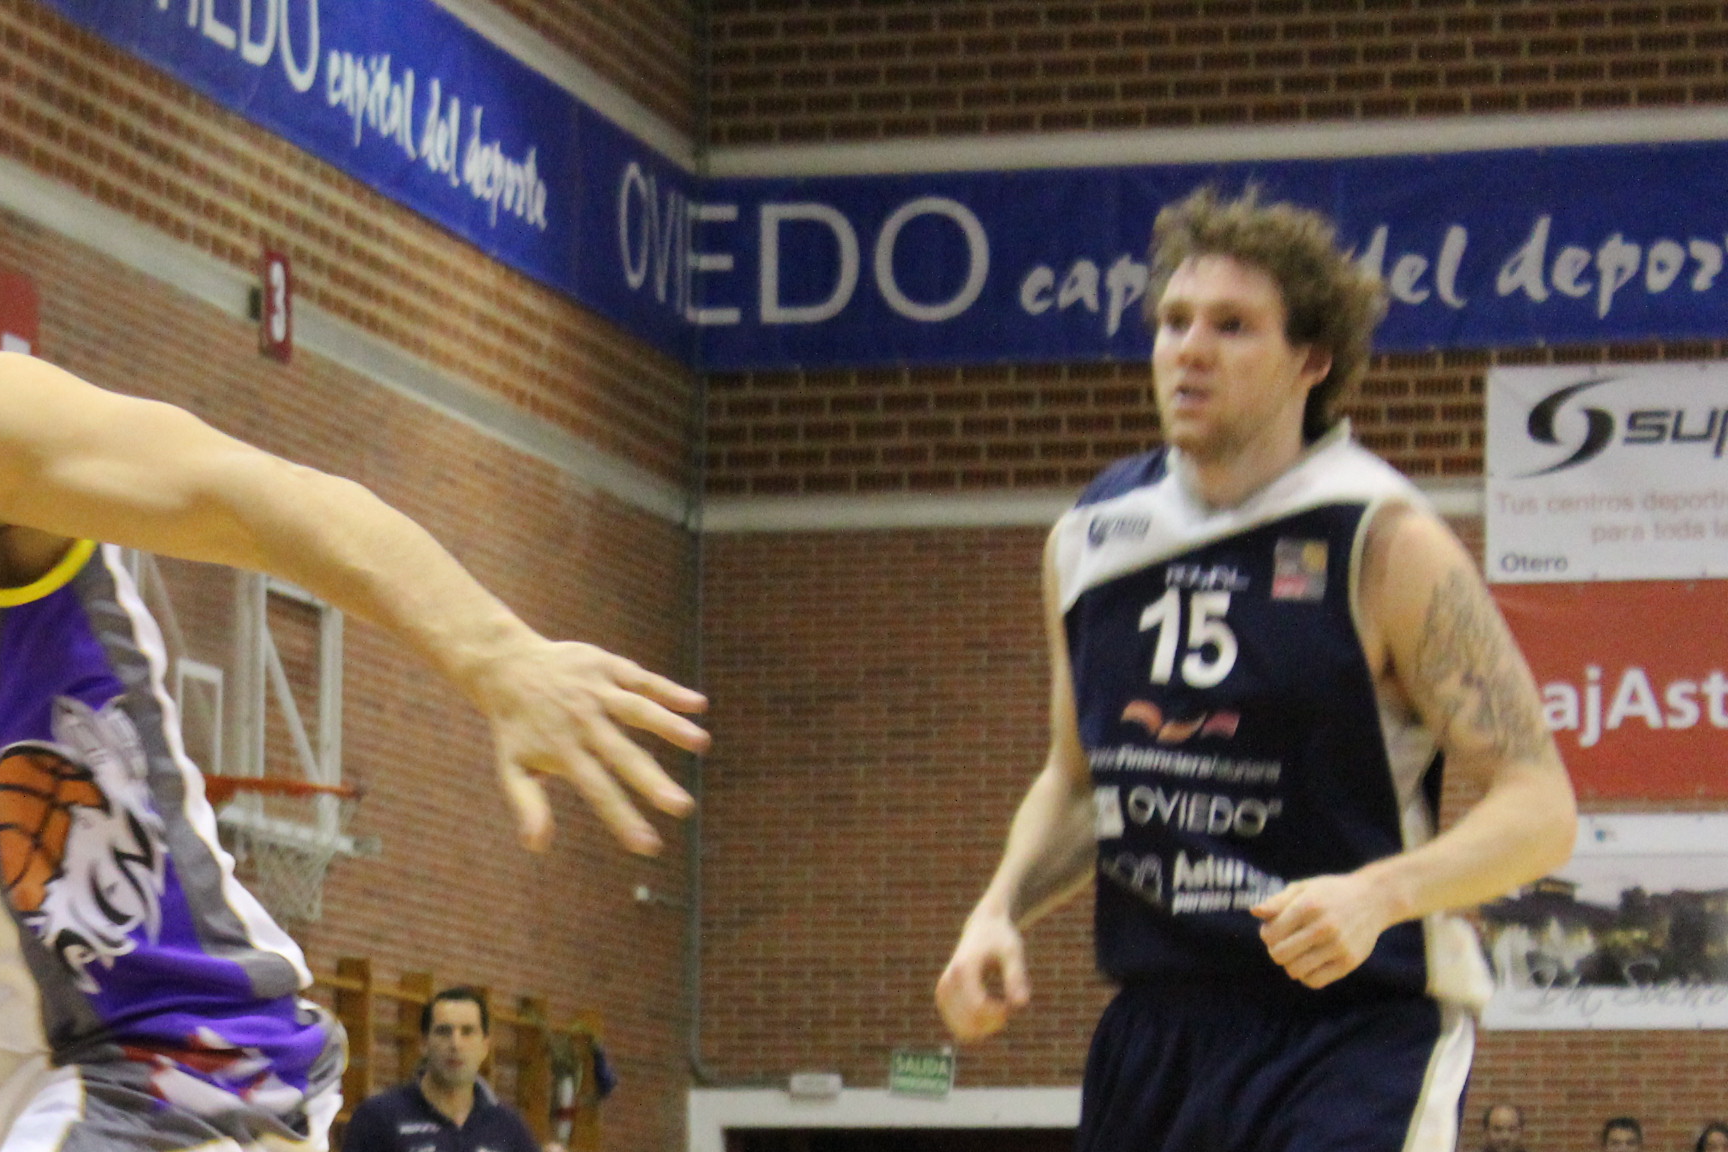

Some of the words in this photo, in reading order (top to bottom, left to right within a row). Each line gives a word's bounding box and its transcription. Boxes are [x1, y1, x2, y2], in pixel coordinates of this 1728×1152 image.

[327, 49, 418, 162] capital
[421, 77, 461, 188] del
[463, 104, 548, 232] deporte
[619, 160, 990, 326] OVIEDO
[1495, 212, 1728, 321] depor
[1500, 553, 1568, 573] Otero
[1138, 588, 1239, 690] 15
[1128, 784, 1269, 838] OVIEDO
